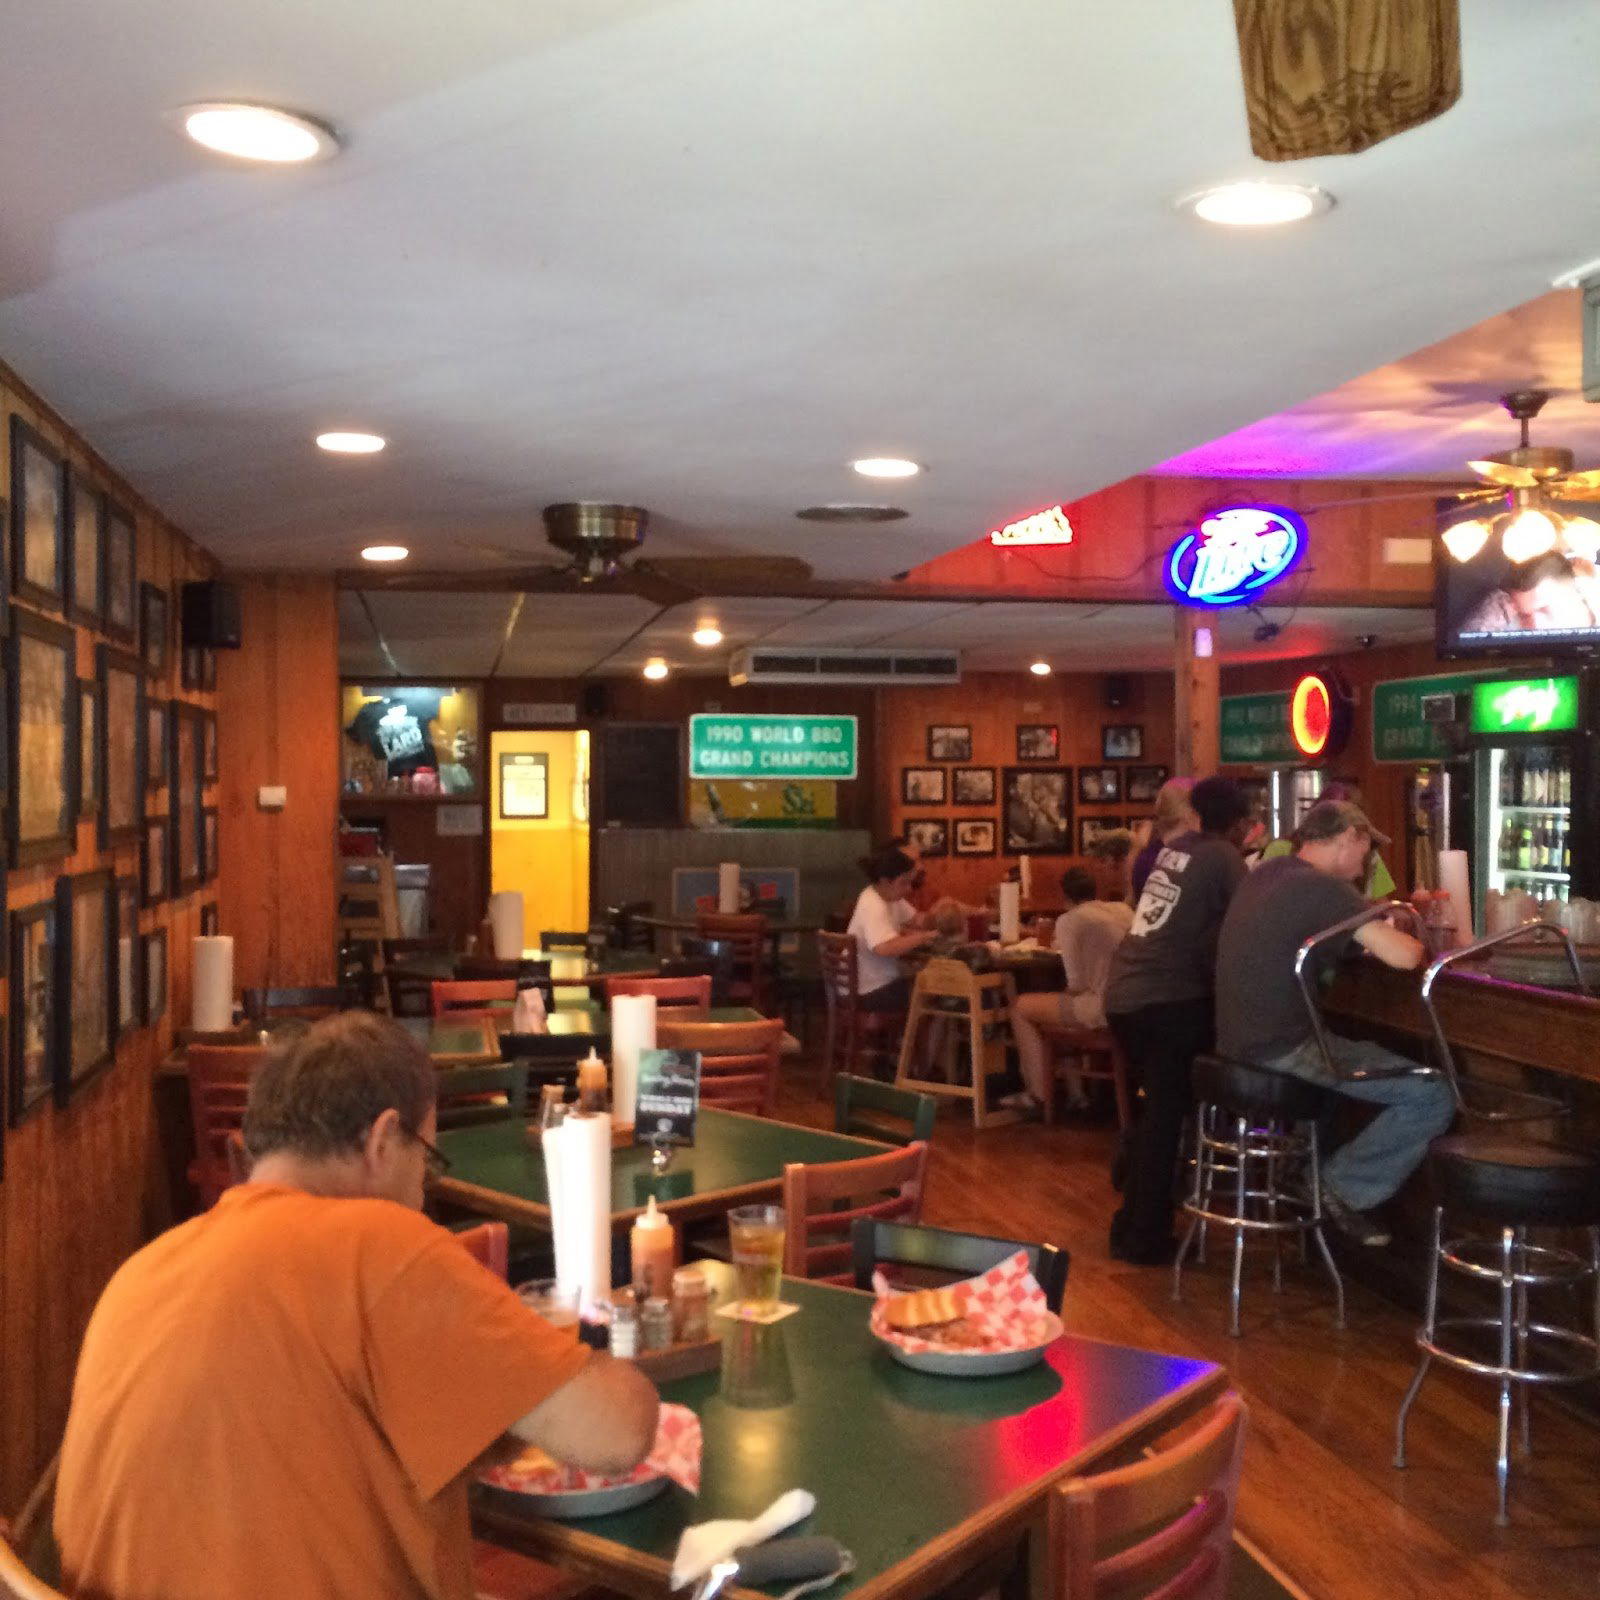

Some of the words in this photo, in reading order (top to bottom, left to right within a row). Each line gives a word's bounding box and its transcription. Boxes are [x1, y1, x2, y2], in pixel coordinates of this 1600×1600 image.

[706, 725, 744, 744] 1990
[751, 726, 805, 744] WORLD
[700, 750, 754, 768] GRAND
[760, 750, 850, 768] CHAMPIONS
